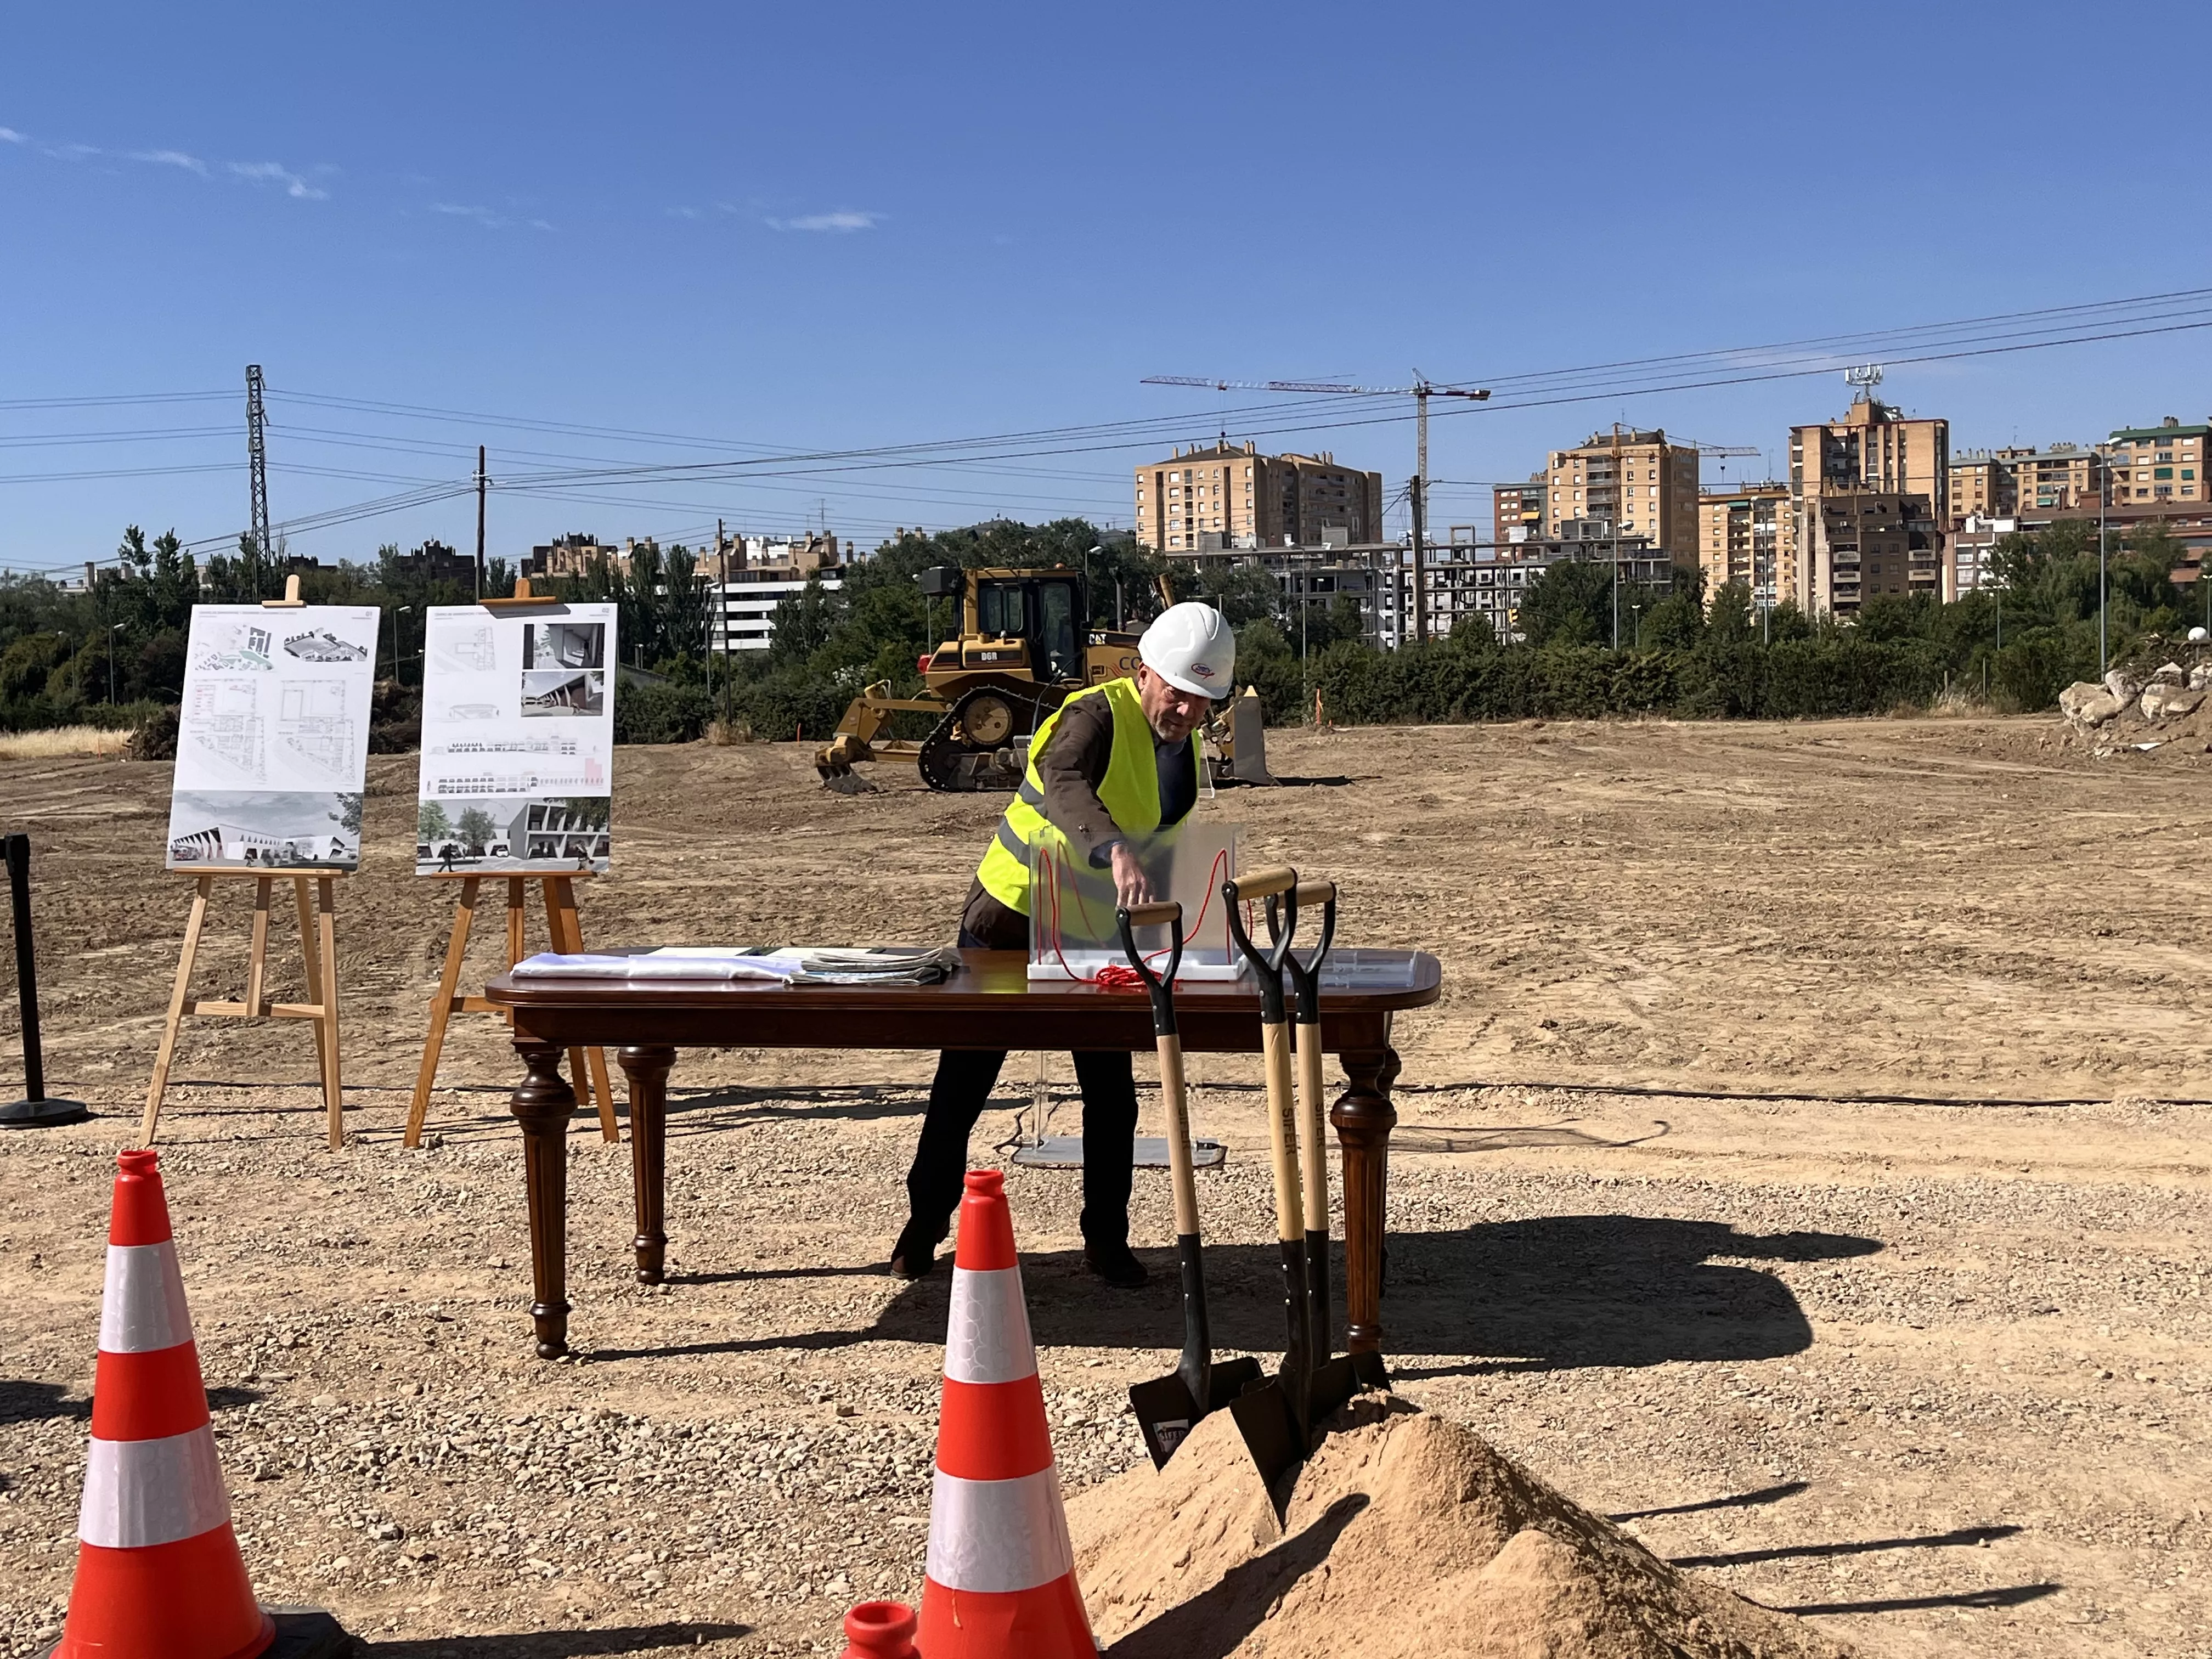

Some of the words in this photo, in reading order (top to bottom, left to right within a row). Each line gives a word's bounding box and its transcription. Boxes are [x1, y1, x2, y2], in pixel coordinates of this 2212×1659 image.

[1088, 633, 1107, 645] CAT
[981, 652, 997, 661] D6R
[1282, 1107, 1296, 1155] SIFER
